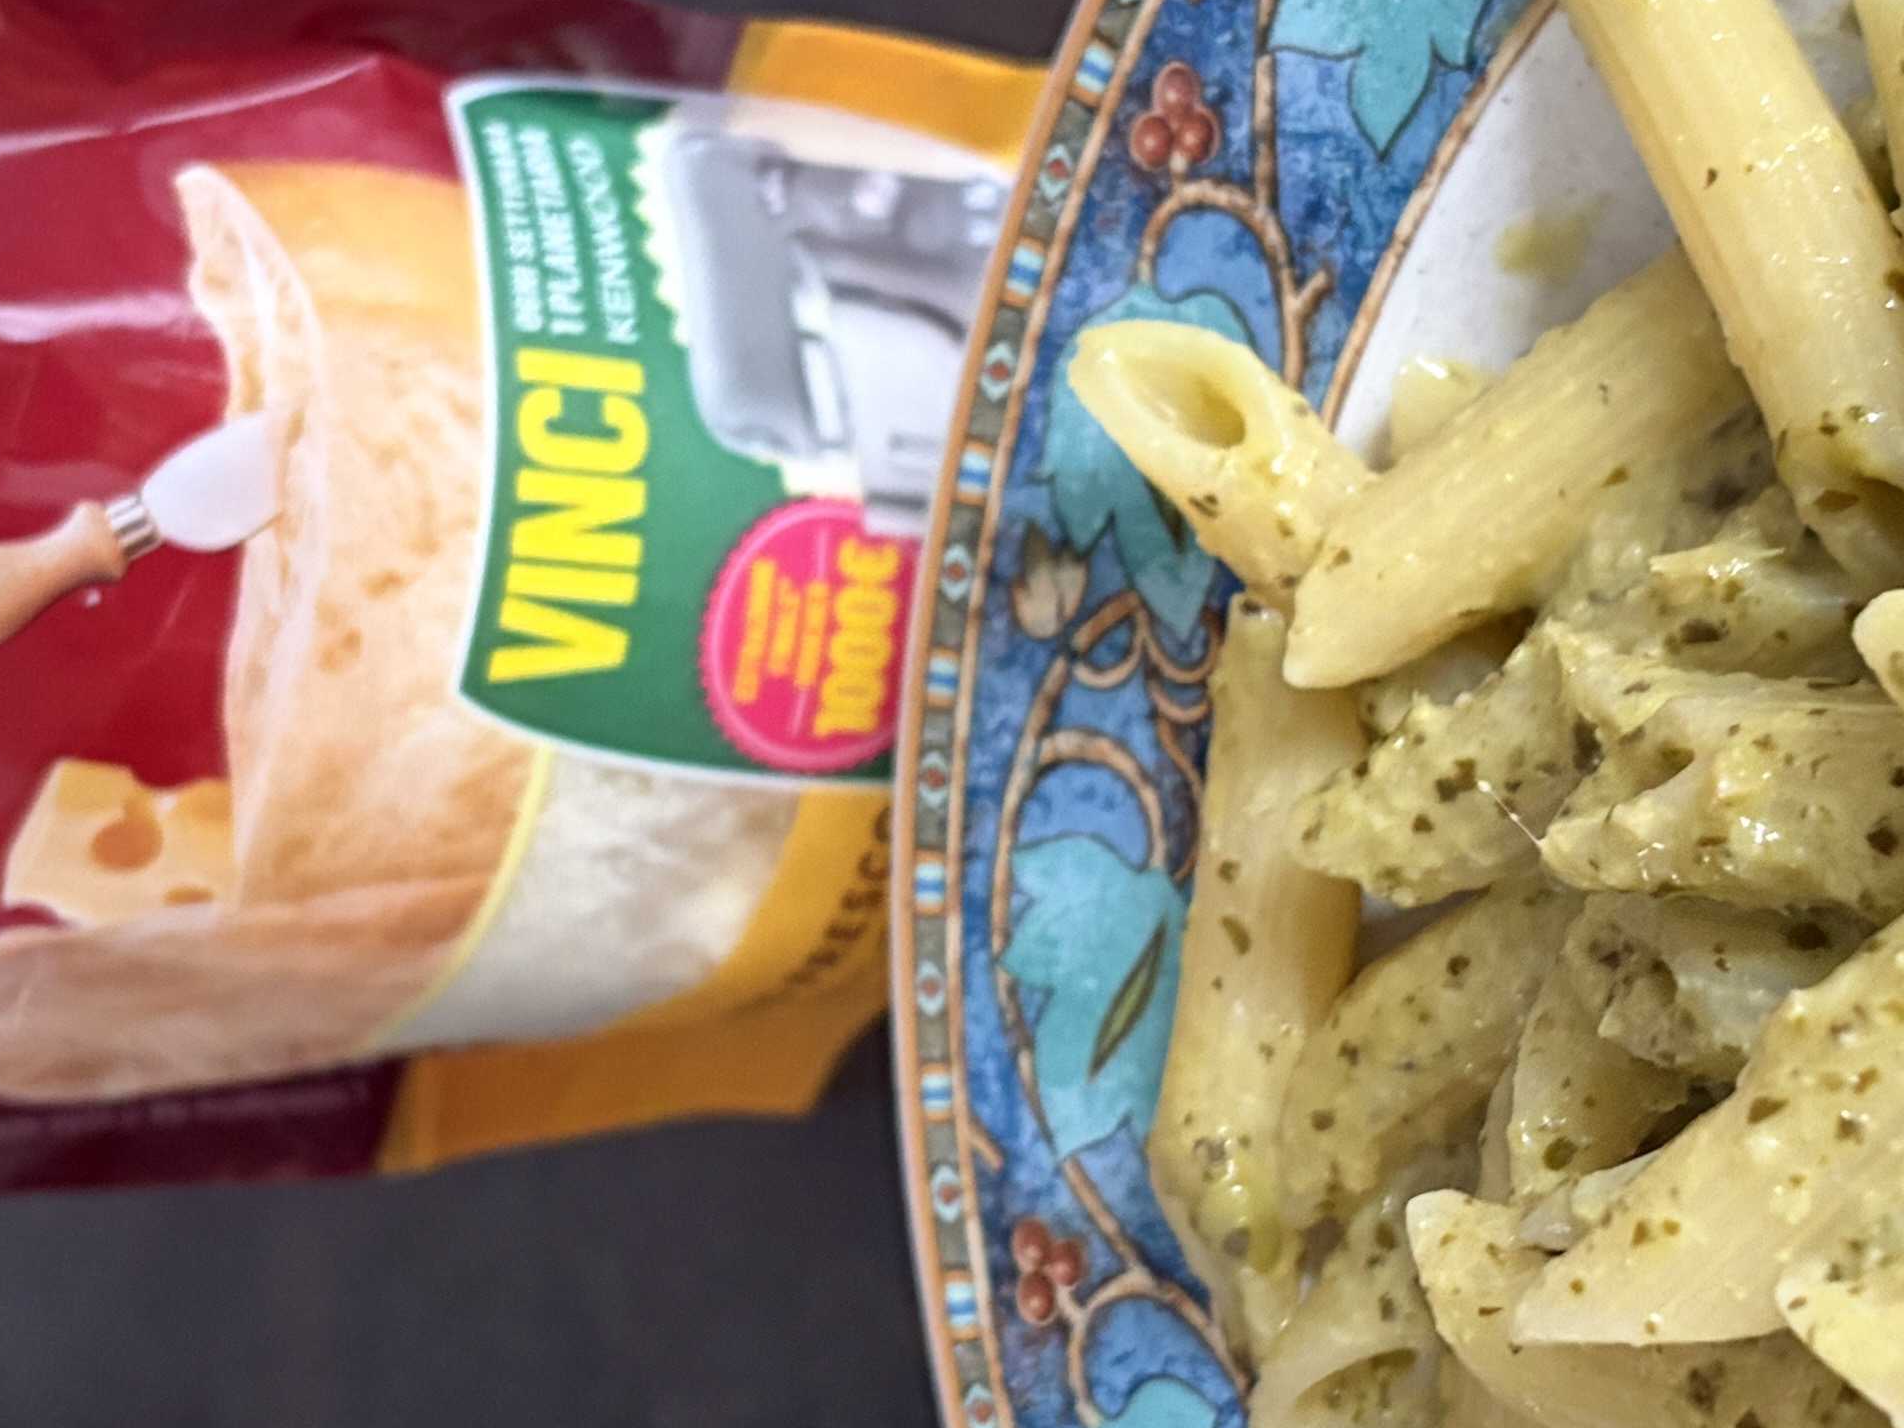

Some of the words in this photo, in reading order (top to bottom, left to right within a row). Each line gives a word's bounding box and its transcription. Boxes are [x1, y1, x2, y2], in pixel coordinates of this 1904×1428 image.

[566, 138, 640, 344] KENWOOD
[486, 346, 652, 684] VINCI
[812, 537, 901, 738] 1000€
